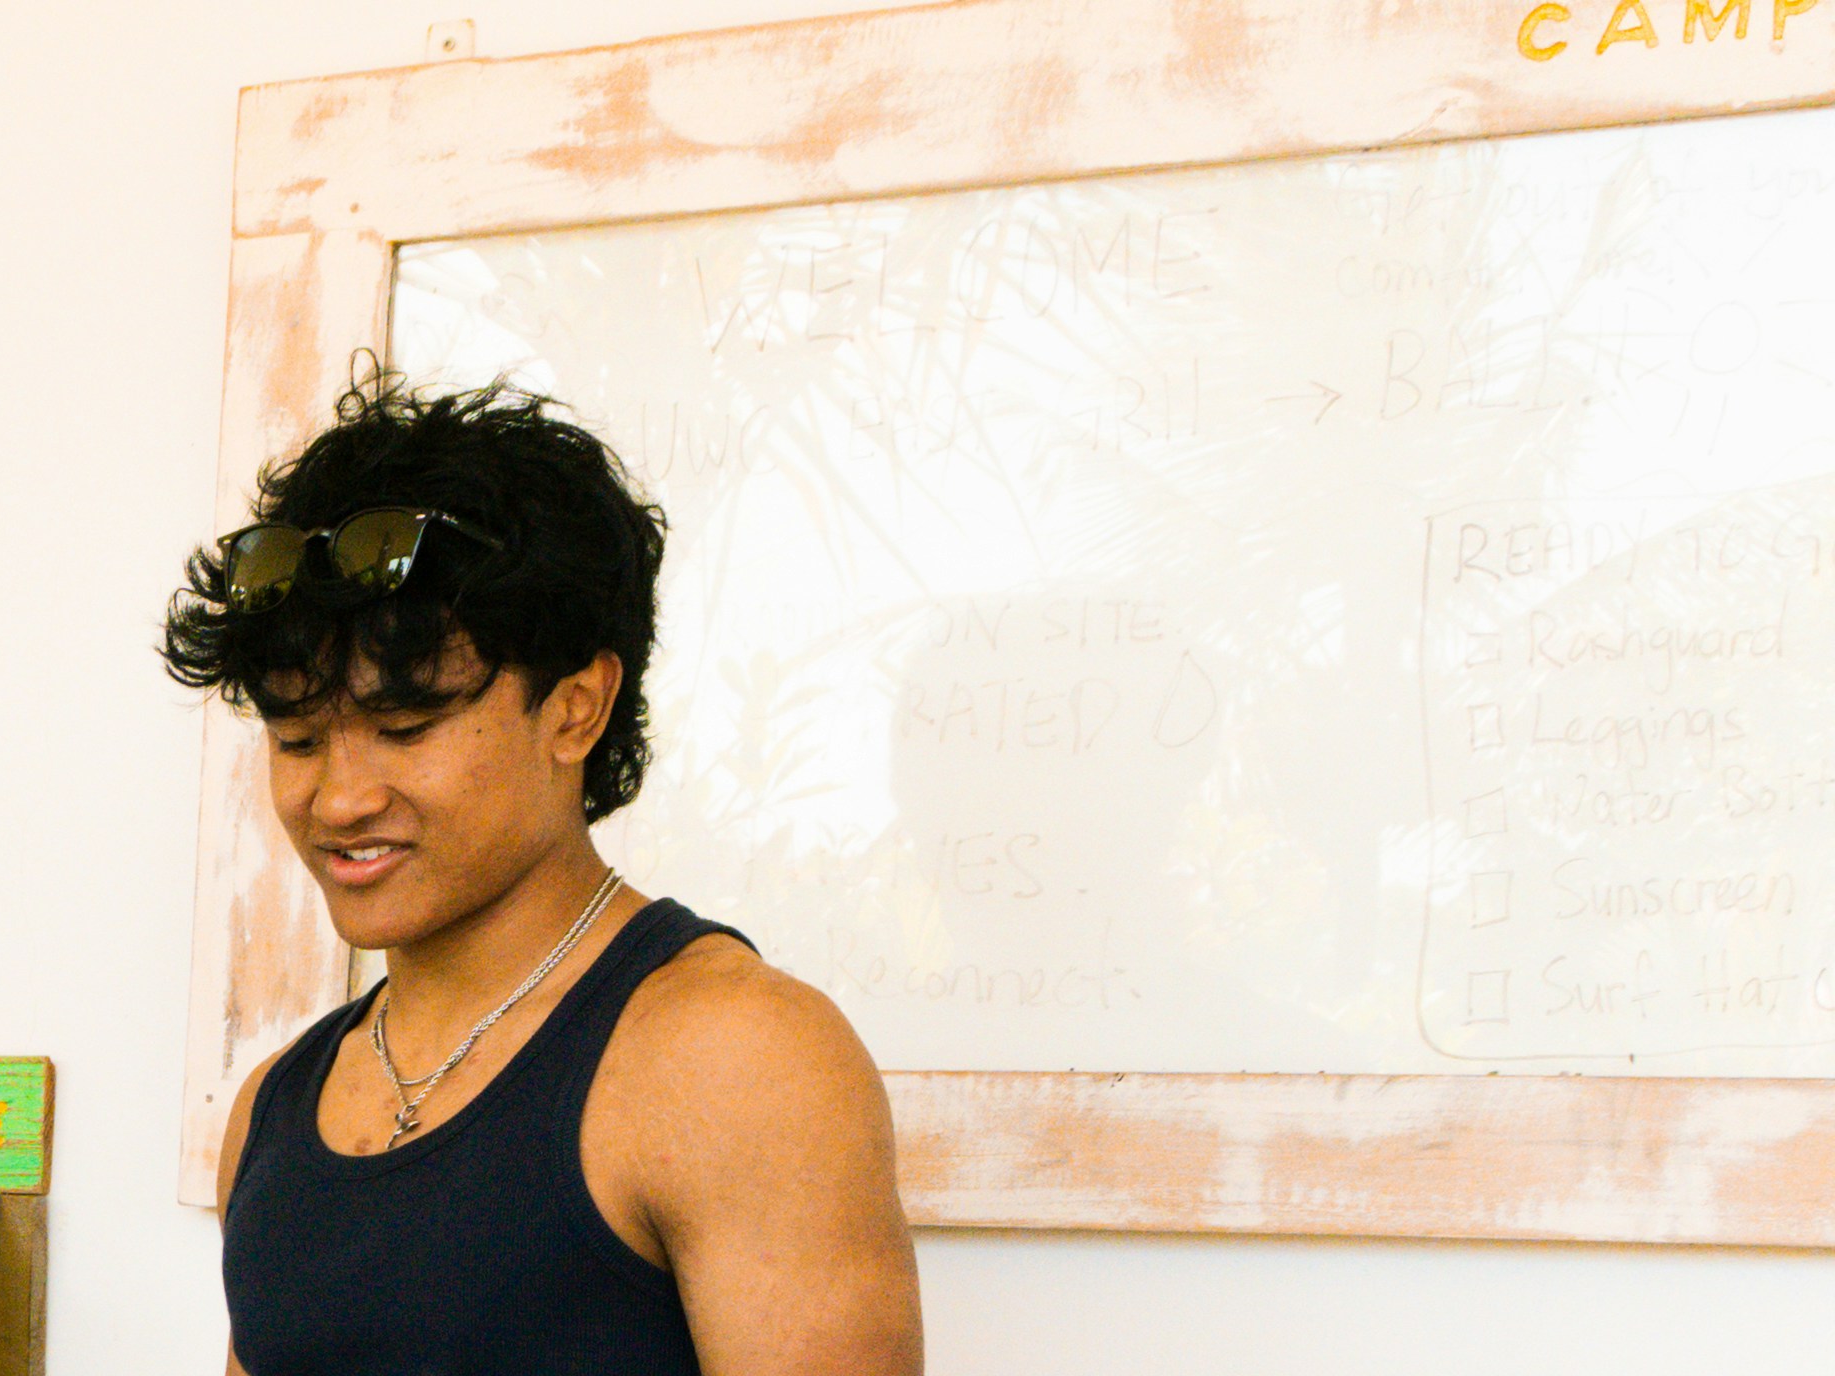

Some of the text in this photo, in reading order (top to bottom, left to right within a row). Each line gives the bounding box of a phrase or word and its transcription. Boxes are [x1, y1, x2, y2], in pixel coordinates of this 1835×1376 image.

[1517, 0, 1818, 62] CAMP
[694, 205, 1221, 354] WELCOME
[1453, 508, 1647, 583] READY
[1526, 588, 1790, 695] Rashguard
[1531, 693, 1747, 771] Leggings
[1550, 857, 1797, 920] Sunscreen
[1539, 949, 1663, 1019] Surf
[1692, 943, 1799, 1016] Hat
